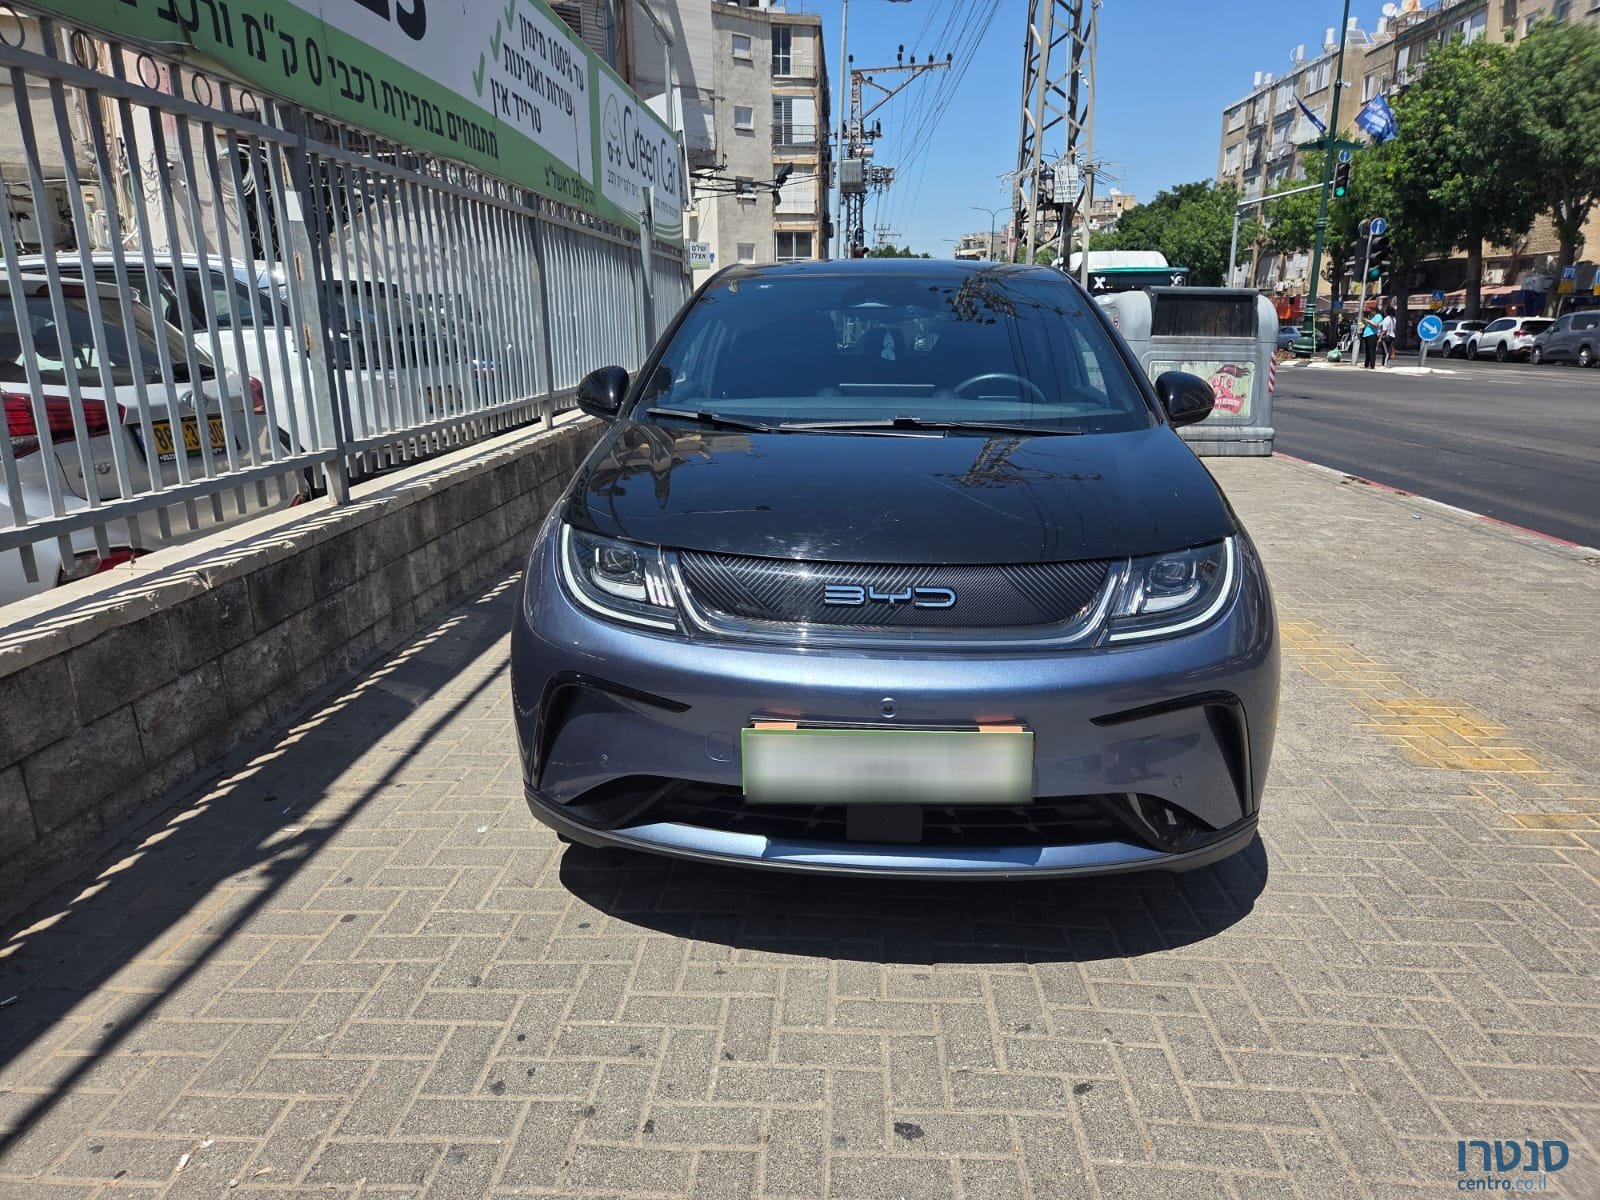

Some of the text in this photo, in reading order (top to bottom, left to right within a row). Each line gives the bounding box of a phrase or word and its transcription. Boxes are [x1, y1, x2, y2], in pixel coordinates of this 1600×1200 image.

[503, 42, 573, 116] שירות ואמינות
[518, 12, 584, 92] עד 100% מימון
[327, 55, 378, 109] רכבי
[380, 80, 444, 137] במכירת
[490, 78, 542, 134] טרייד אין
[446, 110, 499, 159] מתמחים
[623, 105, 676, 196] Green Car
[823, 583, 957, 610] BYD
